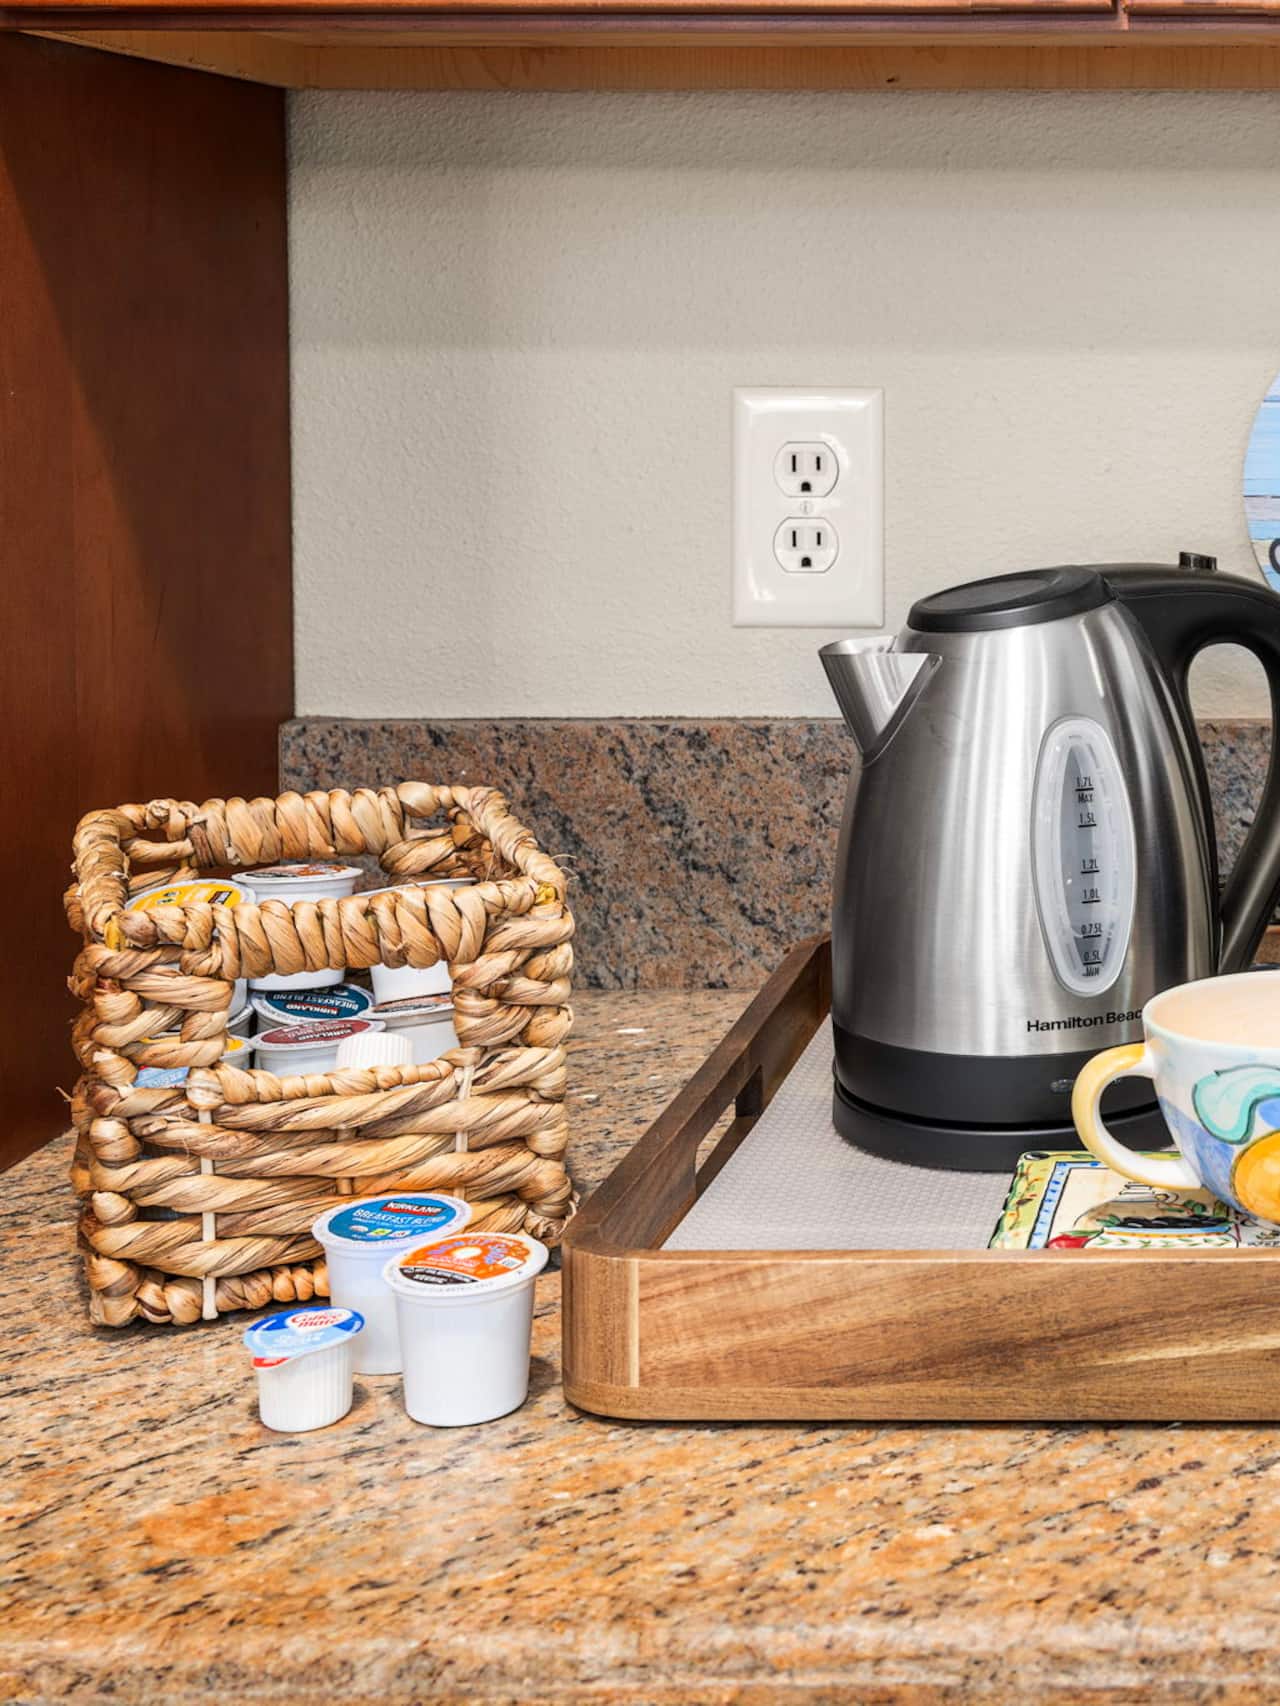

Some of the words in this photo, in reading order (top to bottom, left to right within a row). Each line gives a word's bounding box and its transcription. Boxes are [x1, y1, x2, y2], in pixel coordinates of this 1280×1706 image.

[1026, 1015, 1106, 1033] Hamilton
[1106, 1009, 1143, 1024] Beac
[352, 1208, 410, 1225] BREAKFAST
